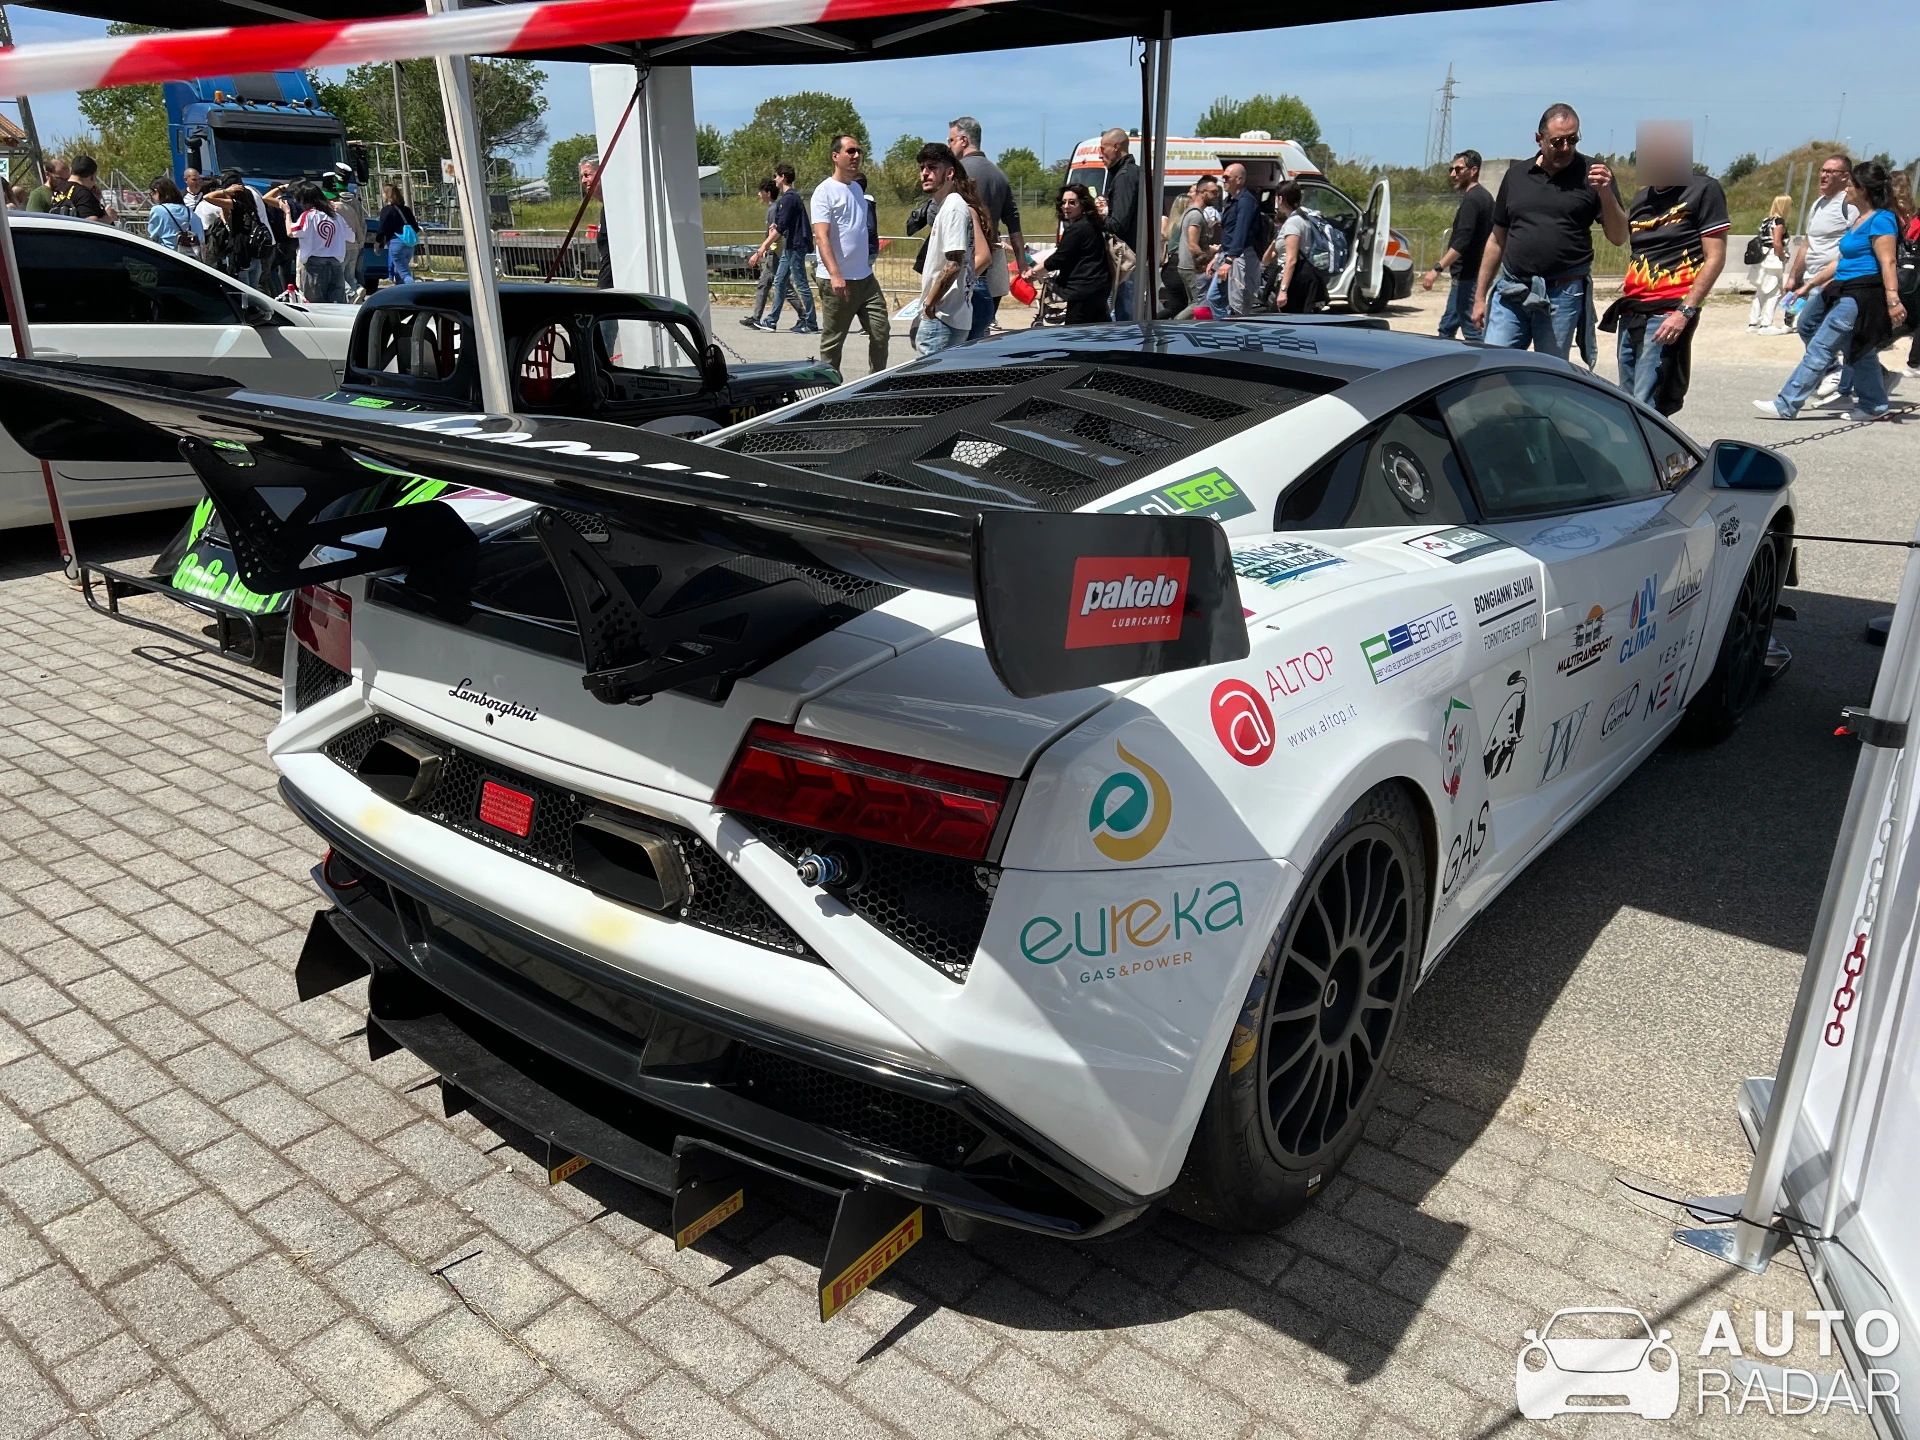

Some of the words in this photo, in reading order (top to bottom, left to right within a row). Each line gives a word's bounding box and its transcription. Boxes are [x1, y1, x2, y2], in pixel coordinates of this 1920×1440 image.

[317, 220, 336, 248] 9
[1080, 574, 1179, 616] pakelo
[1473, 583, 1513, 615] BONGIANNI
[1513, 575, 1534, 598] SILVIA
[1111, 615, 1172, 628] LUBRICANTS
[1483, 625, 1511, 652] FORNITURE
[1511, 620, 1521, 638] PER
[1520, 612, 1538, 633] UFFICIO
[1619, 621, 1657, 664] CLIMA
[1266, 645, 1334, 702] ALTOP
[448, 677, 539, 722] Lamborghini
[1287, 702, 1358, 749] www.altop.it
[1442, 800, 1489, 895] GAS
[1019, 880, 1244, 965] eureka
[1079, 951, 1194, 984] GAS&POWER
[682, 1194, 740, 1246] PIRELLI
[833, 1218, 915, 1310] PIRELLI
